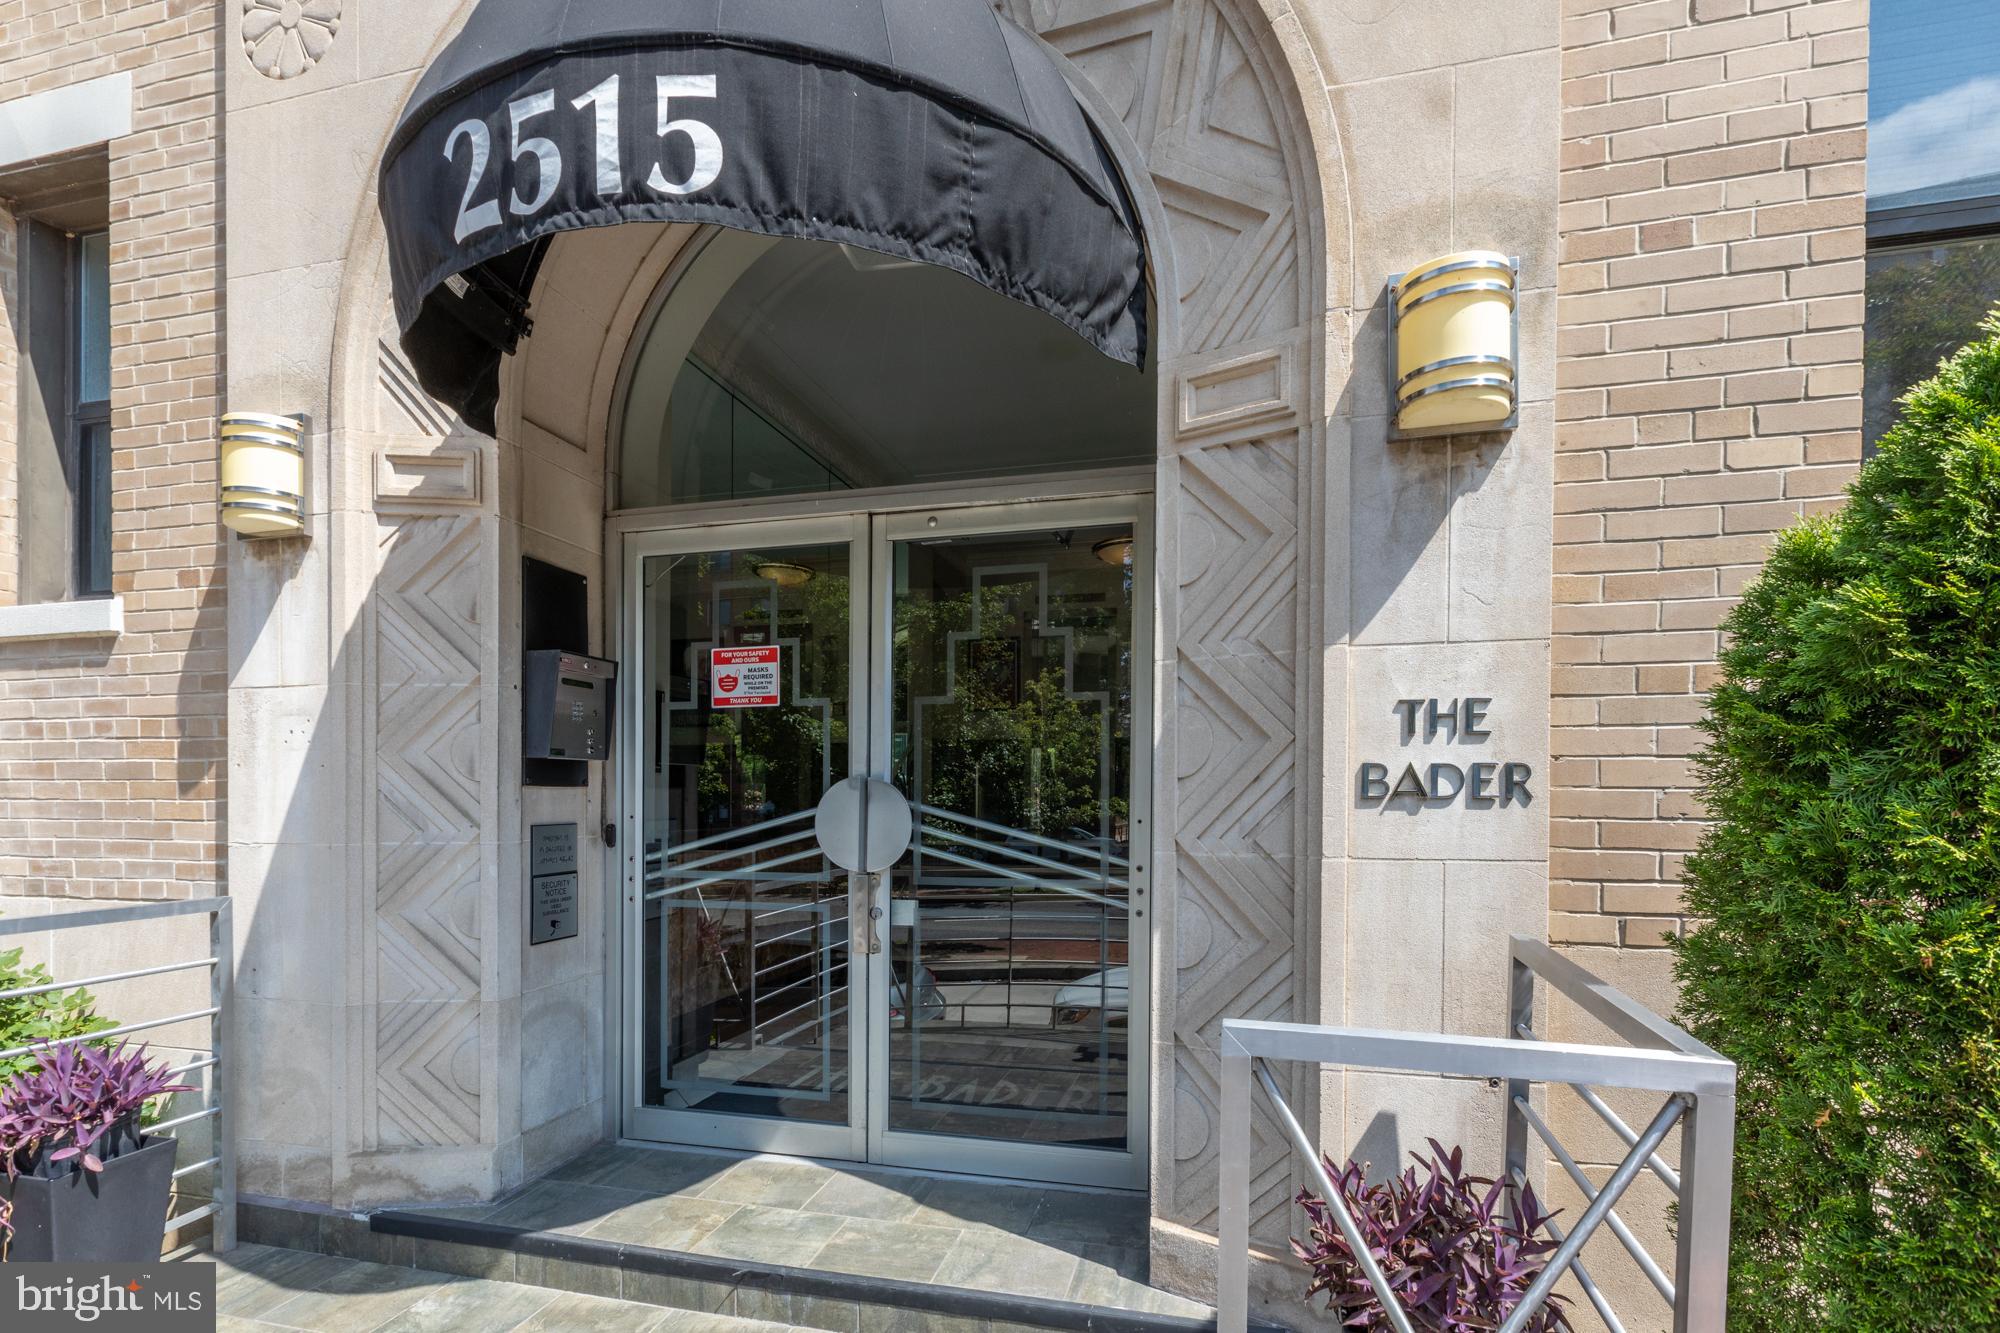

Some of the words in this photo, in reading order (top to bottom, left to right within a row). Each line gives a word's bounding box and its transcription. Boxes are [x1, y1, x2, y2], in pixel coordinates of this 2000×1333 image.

[443, 74, 724, 245] 2515
[1397, 697, 1493, 736] THE
[1360, 761, 1534, 801] BADER
[541, 879, 571, 890] SECURITY
[544, 887, 567, 897] NOTICE
